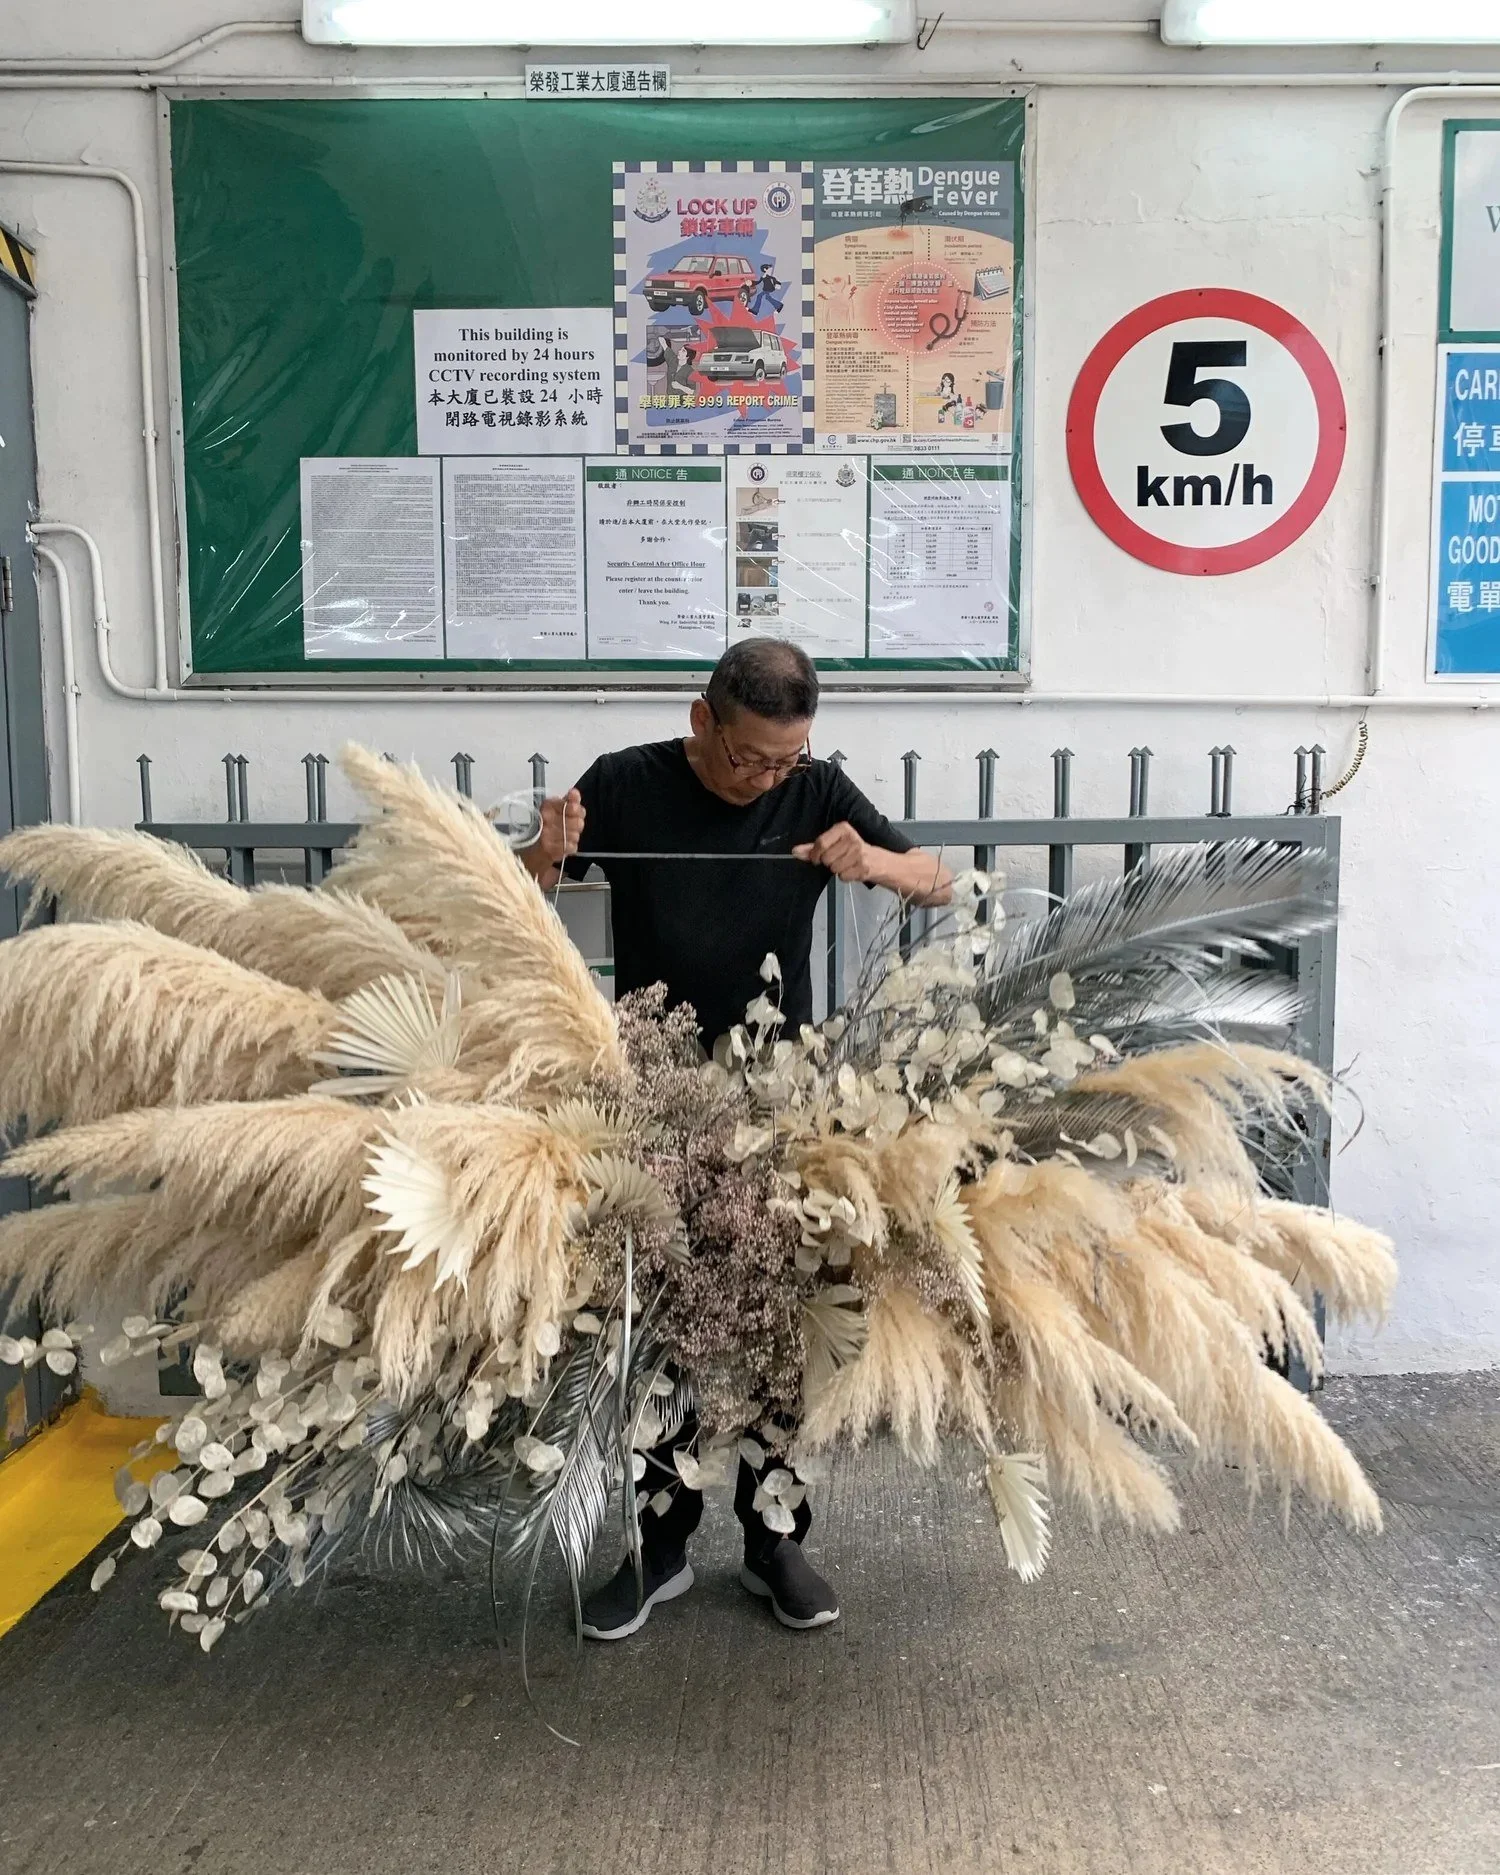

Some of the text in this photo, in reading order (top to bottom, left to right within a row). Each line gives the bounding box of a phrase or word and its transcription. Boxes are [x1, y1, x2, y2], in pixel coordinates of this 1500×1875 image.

[530, 70, 667, 92] 榮發工業大廈通告欄
[822, 167, 914, 205] 登革熱
[918, 166, 1000, 189] Dengue
[933, 187, 998, 206] Fever
[677, 198, 728, 215] LOCK
[732, 198, 758, 215] UP
[459, 328, 569, 343] This building is
[434, 348, 595, 364] monitored by 24 hours
[428, 369, 600, 384] CCTV recording system
[428, 387, 604, 406] 本大廈已裝設 24 小時
[699, 394, 799, 409] 999 REPORT CRIME
[1160, 340, 1251, 456] 5
[445, 409, 588, 428] 閉路電視錄影系統
[615, 468, 688, 480] 通 NOTICE 告
[902, 467, 975, 479] 通 NOTICE 告
[1137, 463, 1273, 506] km/h
[1468, 494, 1500, 523] MO
[1448, 536, 1500, 564] GOOD
